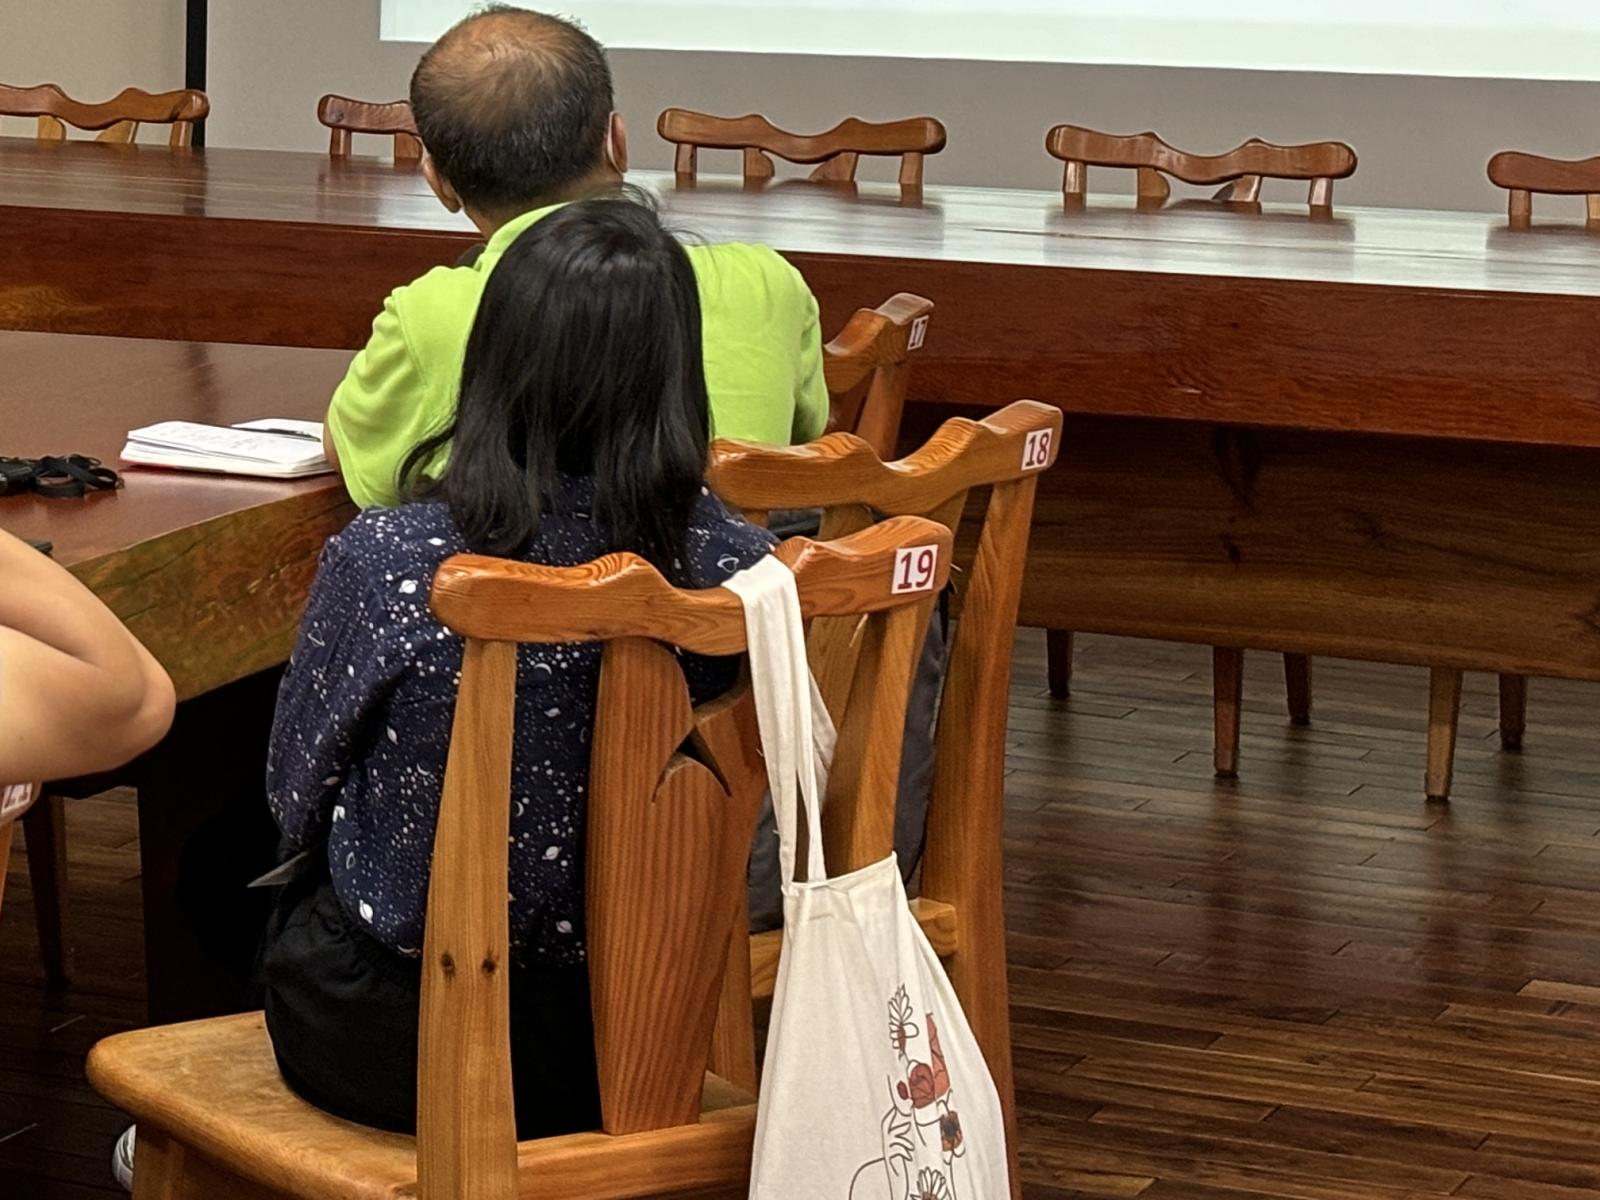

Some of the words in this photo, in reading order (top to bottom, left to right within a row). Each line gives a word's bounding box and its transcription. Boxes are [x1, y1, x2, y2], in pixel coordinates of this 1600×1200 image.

[910, 319, 927, 347] 17
[1025, 432, 1049, 466] 18
[898, 550, 933, 589] 19
